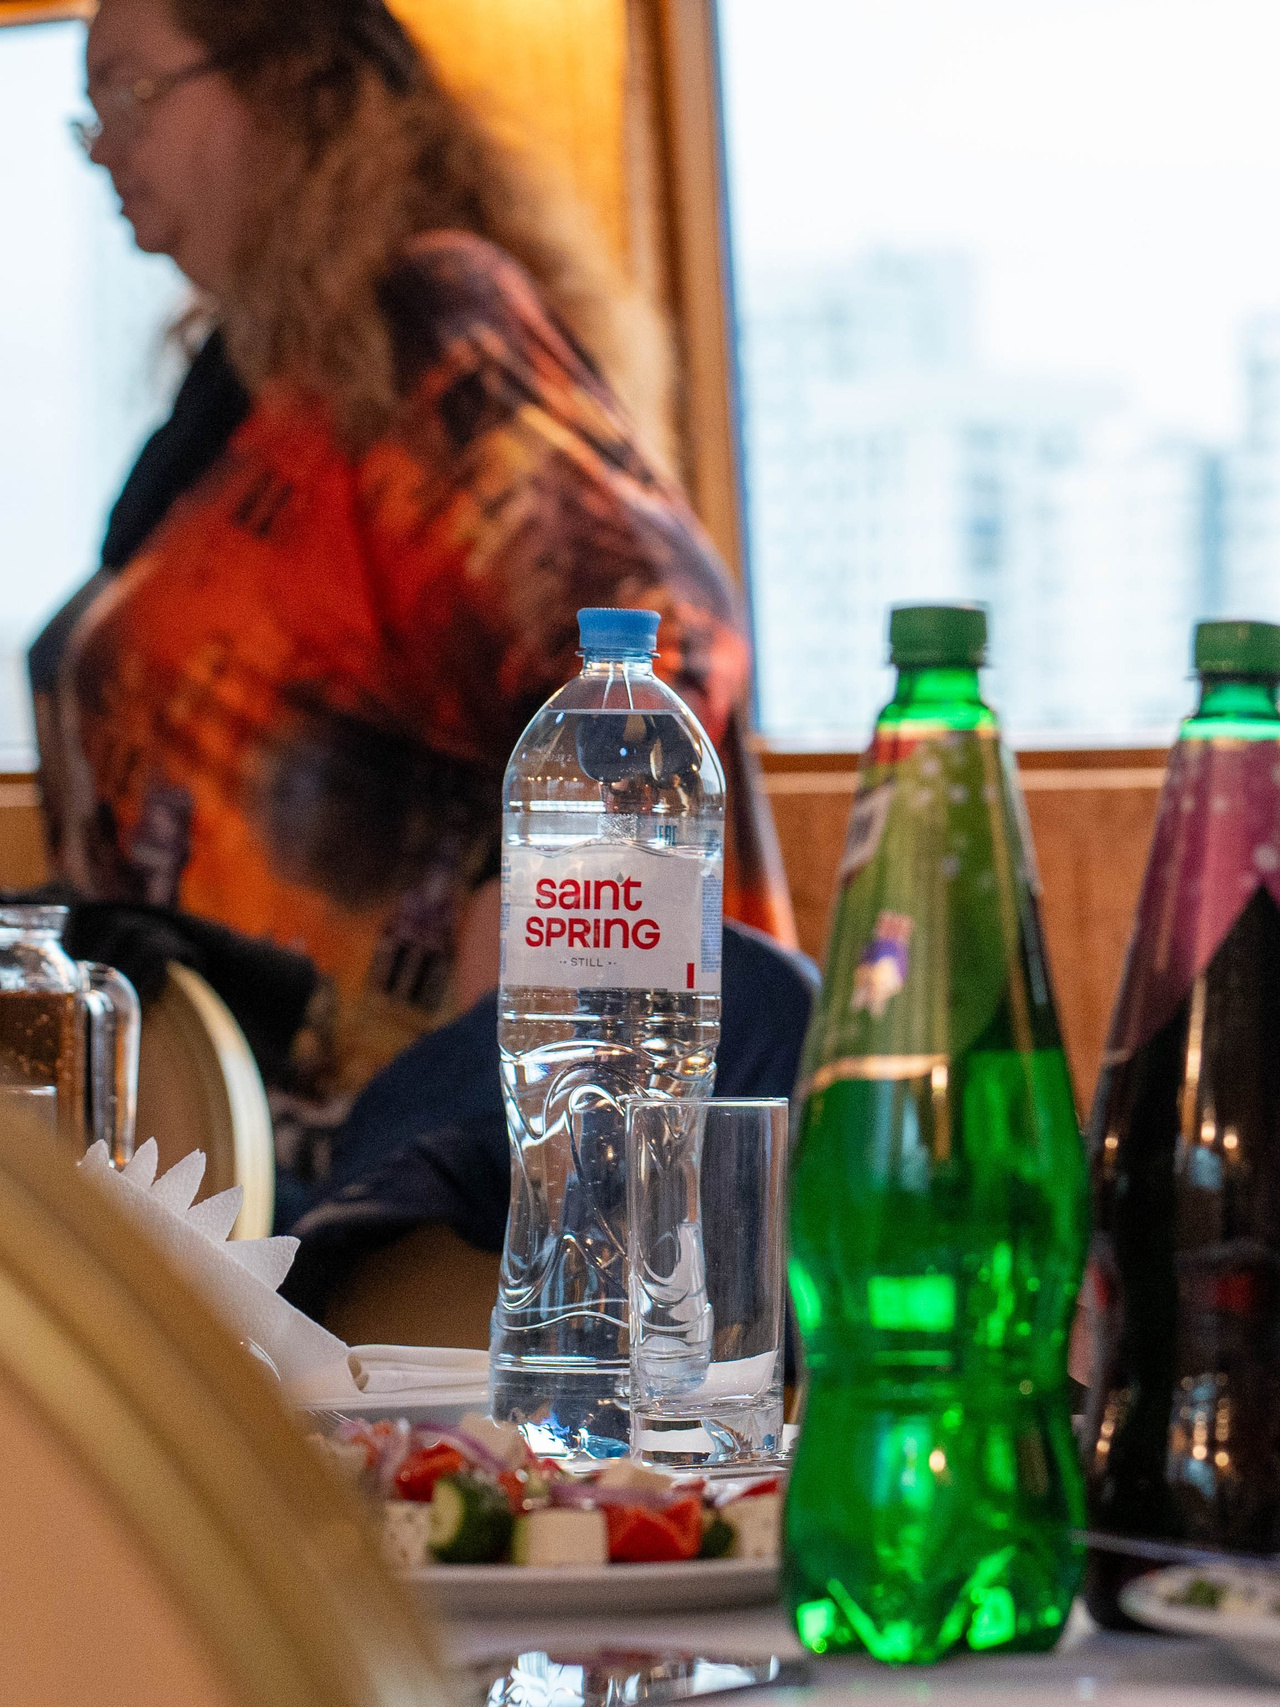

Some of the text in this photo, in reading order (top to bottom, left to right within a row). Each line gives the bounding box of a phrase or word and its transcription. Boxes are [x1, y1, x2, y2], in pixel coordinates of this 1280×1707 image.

[535, 876, 643, 912] saint
[525, 916, 661, 950] SPRING
[570, 957, 604, 967] STILL
